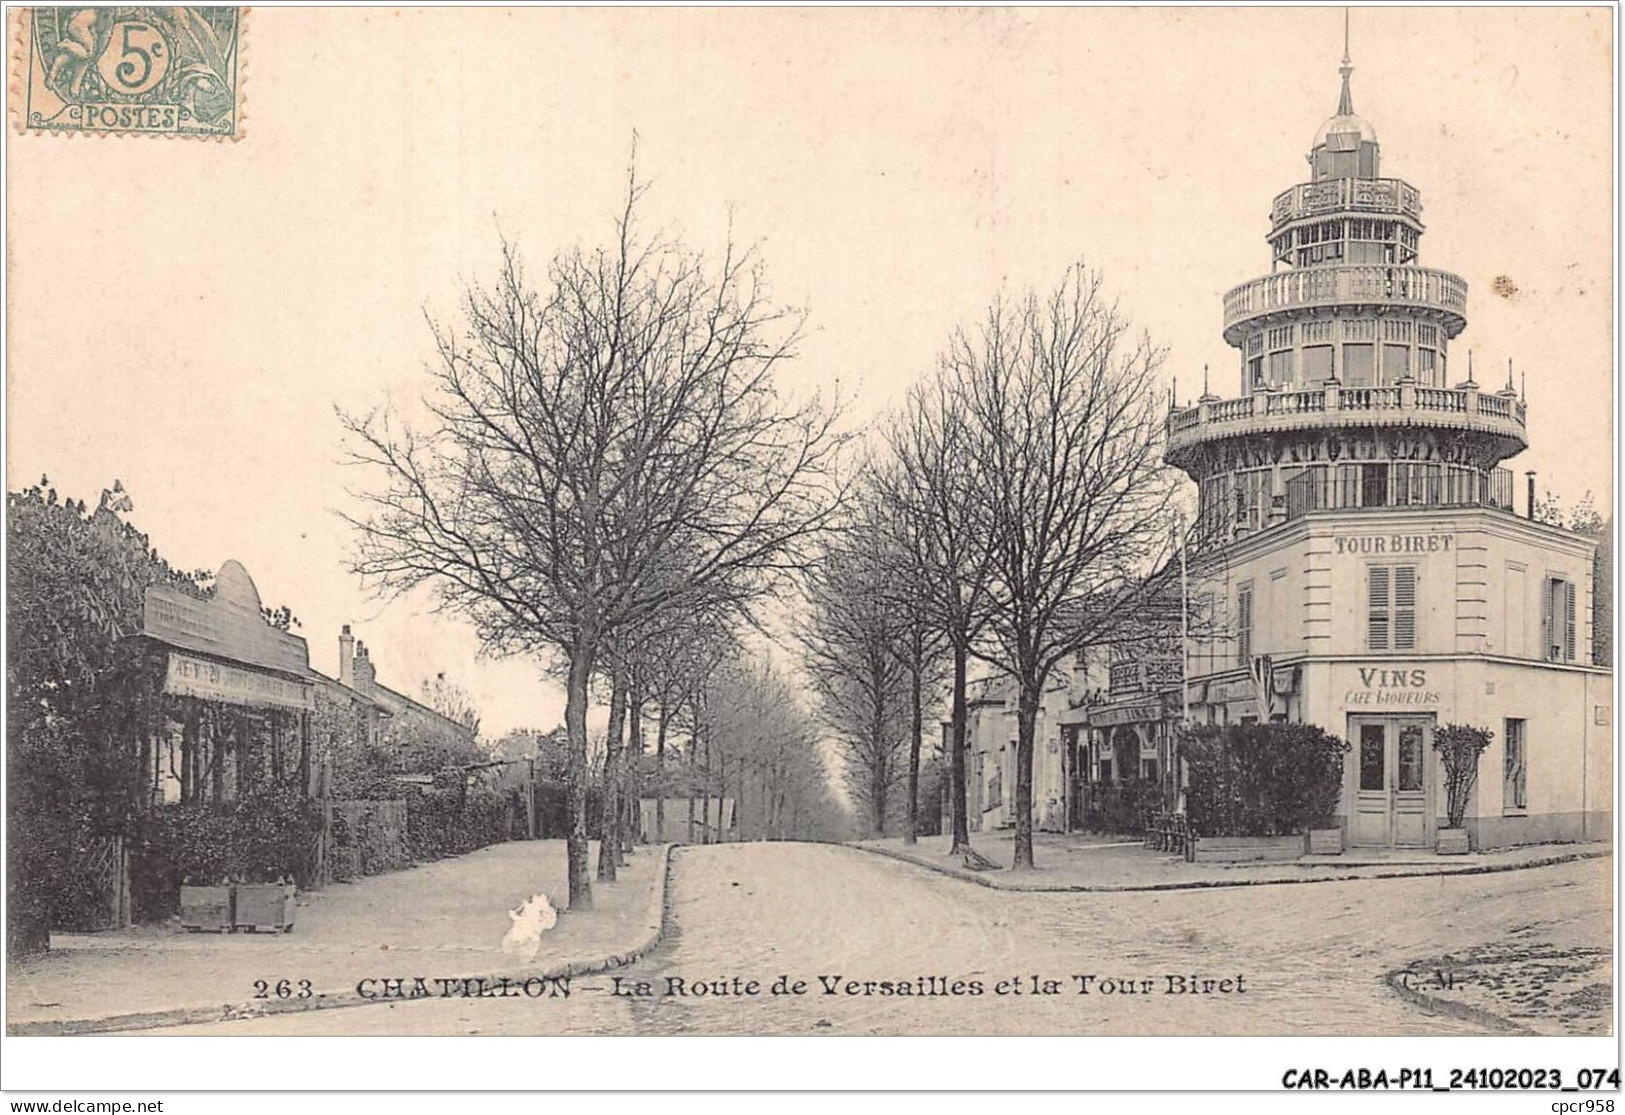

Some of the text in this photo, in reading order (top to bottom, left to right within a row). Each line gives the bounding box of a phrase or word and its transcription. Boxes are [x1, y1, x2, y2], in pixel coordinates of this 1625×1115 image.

[85, 106, 176, 128] POSTES
[1335, 534, 1454, 554] TOUR BIRET
[1358, 667, 1427, 688] VINS
[1376, 690, 1440, 705] LIQUEURS
